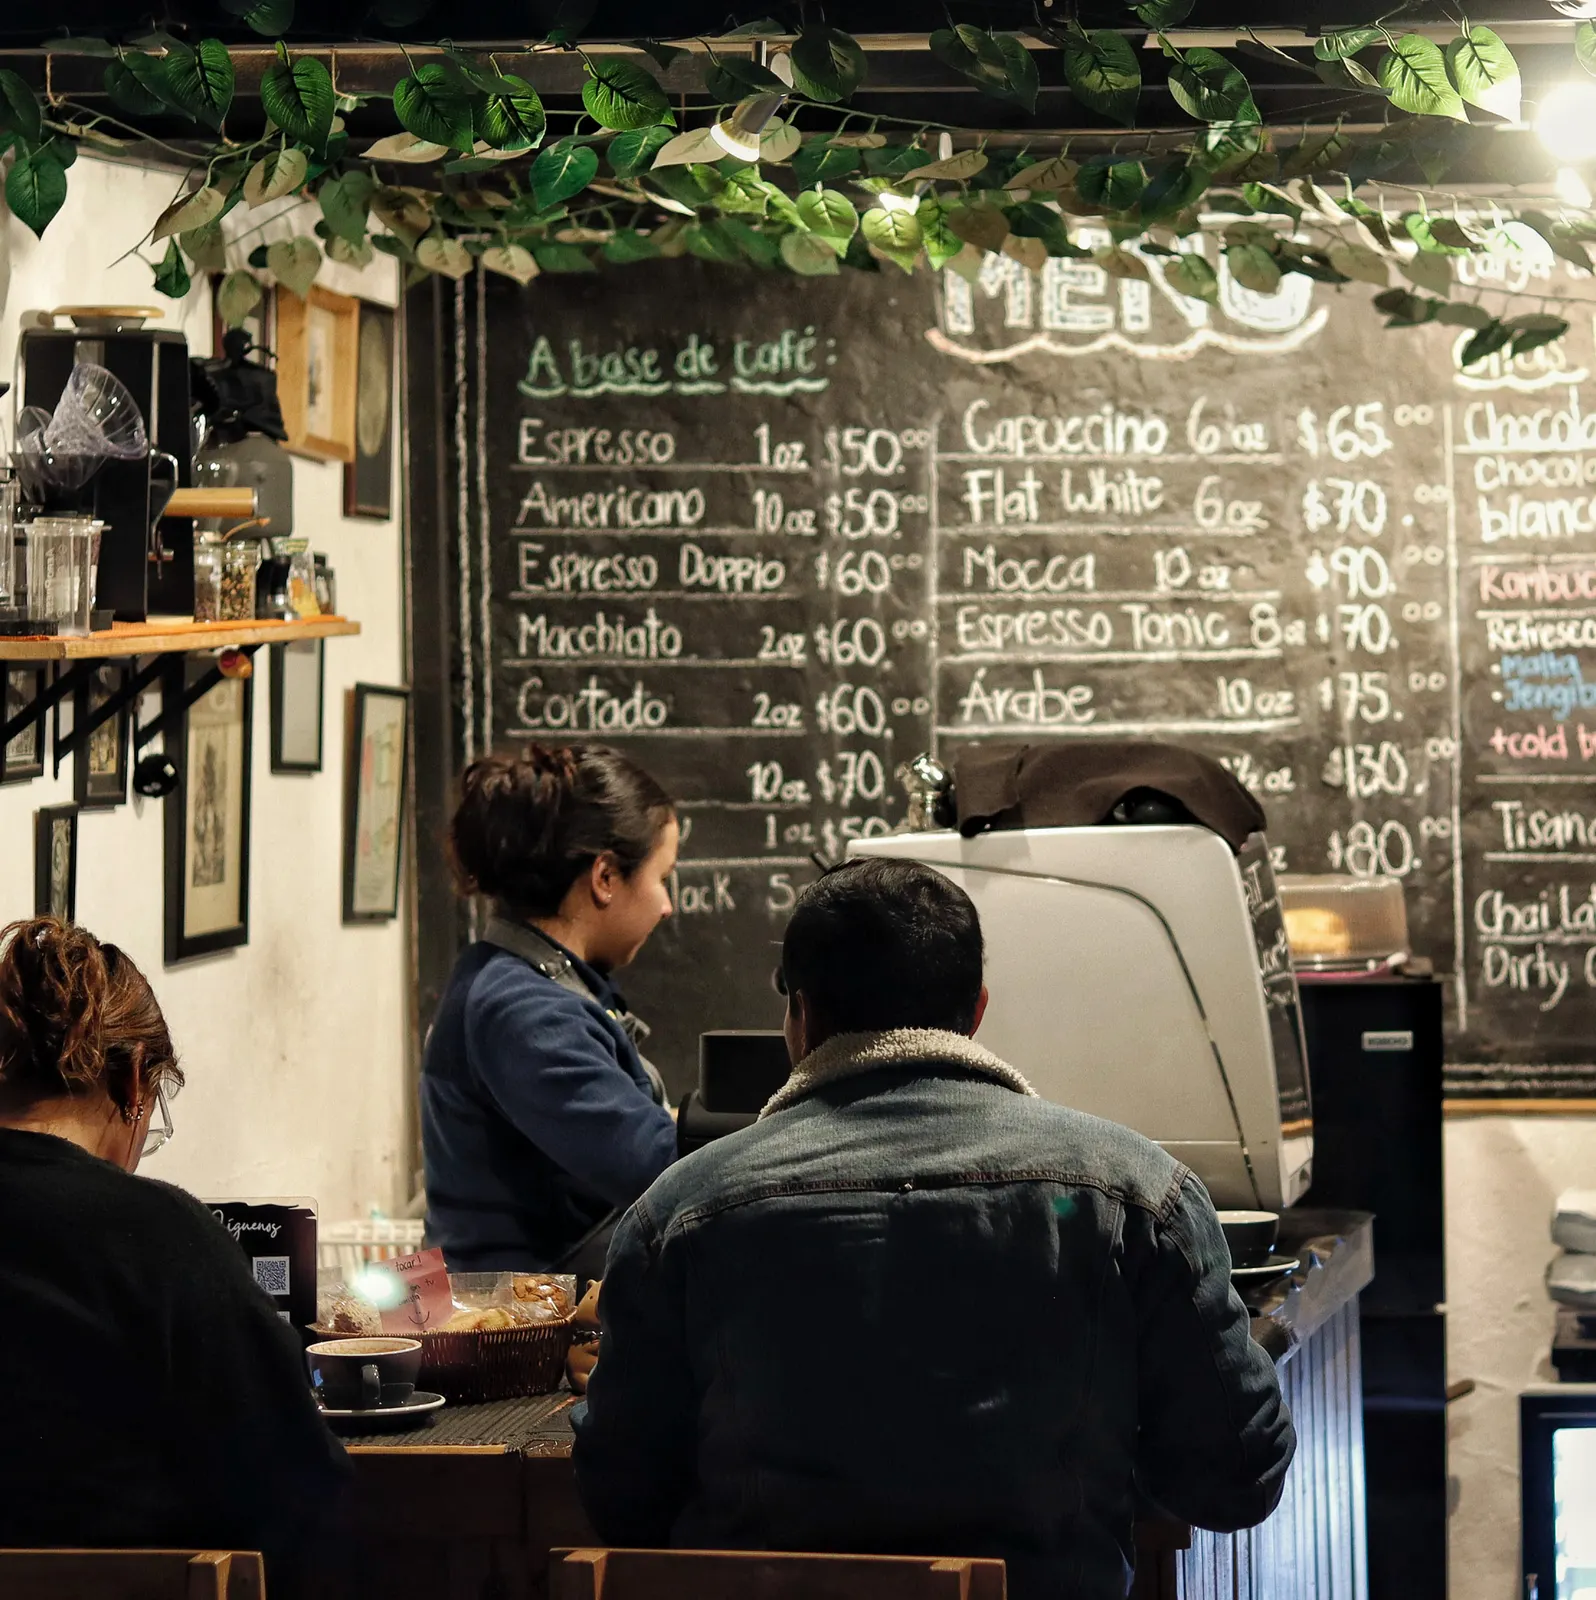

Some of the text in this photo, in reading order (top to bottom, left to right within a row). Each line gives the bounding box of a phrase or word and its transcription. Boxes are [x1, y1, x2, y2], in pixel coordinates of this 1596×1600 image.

[526, 335, 562, 386] A
[569, 339, 662, 387] base
[675, 333, 720, 379] de
[518, 418, 676, 464] Espresso
[962, 399, 1169, 459] Capuccino
[515, 481, 706, 530] Americano
[962, 467, 1044, 526] Flat
[1062, 468, 1164, 516] White
[518, 542, 659, 592] Espresso
[678, 543, 787, 592] Doppio
[962, 544, 1097, 592] Mocca
[518, 608, 683, 659] Macchiato
[956, 604, 1114, 651] Espresso
[1119, 603, 1231, 650] Tonic
[517, 675, 668, 730] Cortado
[958, 667, 1098, 723] Árabe
[1474, 887, 1550, 935] Chai
[1483, 942, 1569, 1012] Dirty
